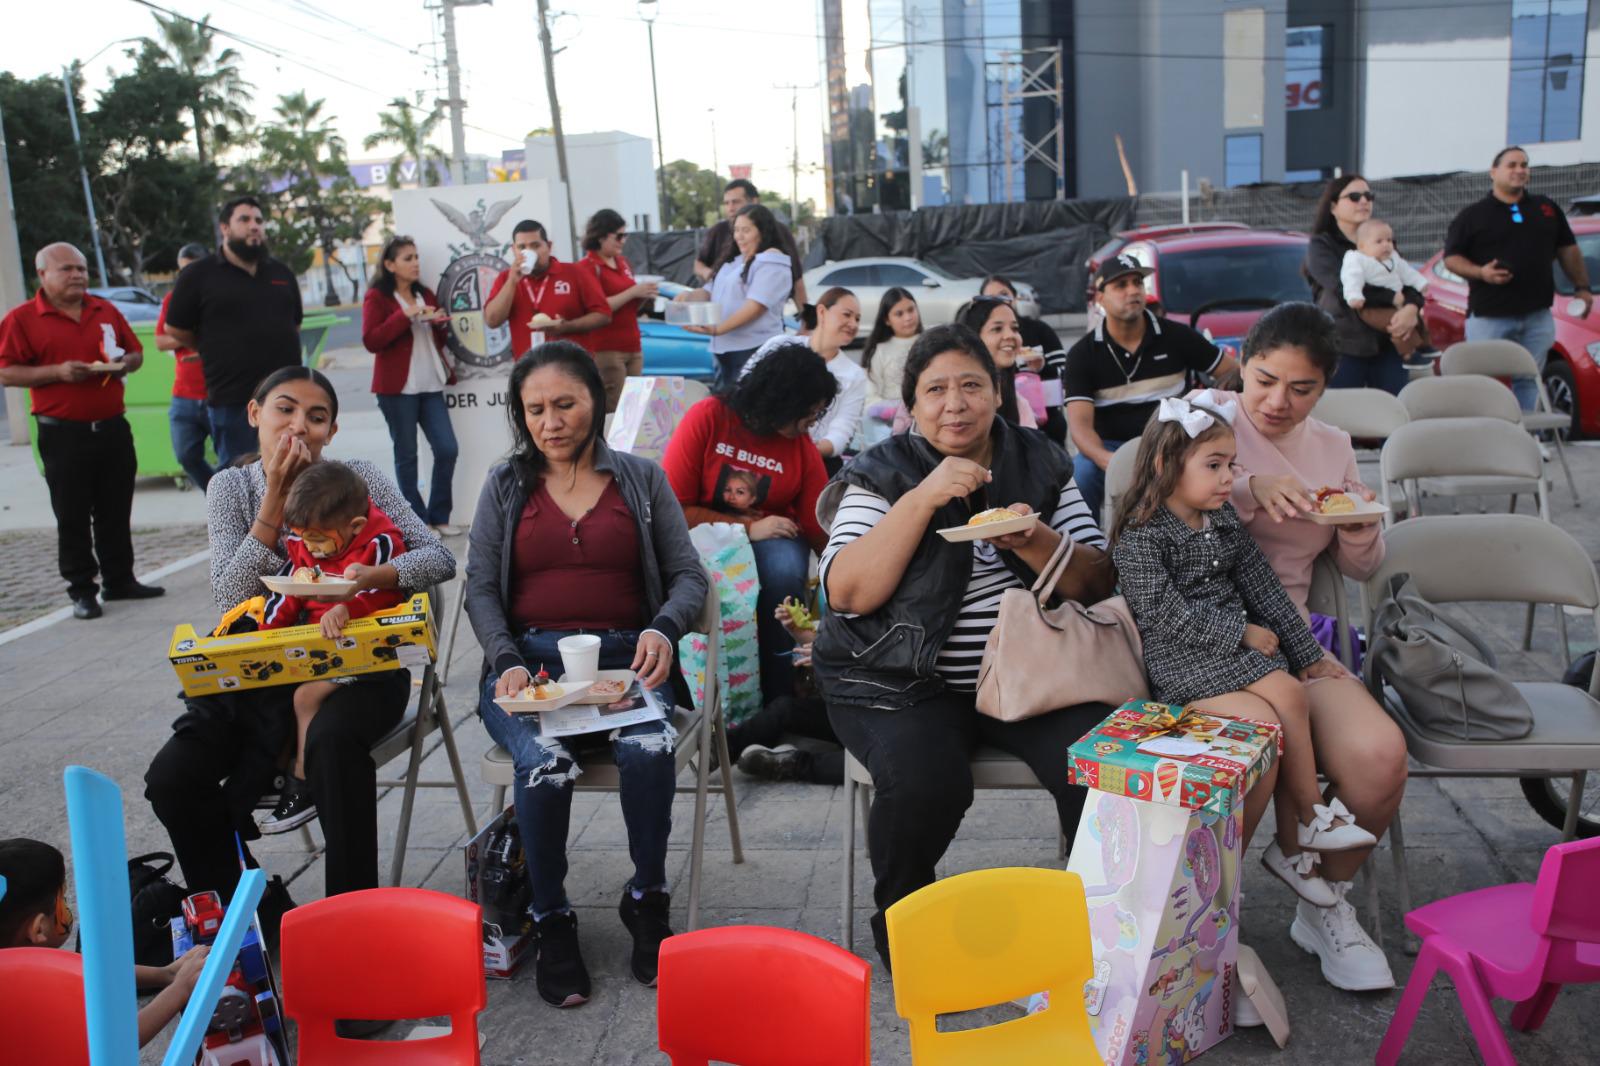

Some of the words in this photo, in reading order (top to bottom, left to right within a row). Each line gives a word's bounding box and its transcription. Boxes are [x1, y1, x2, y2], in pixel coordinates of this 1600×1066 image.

[446, 393, 478, 408] DER
[715, 442, 735, 458] SE
[736, 449, 784, 474] BUSCA
[1218, 961, 1233, 1036] Scooter
